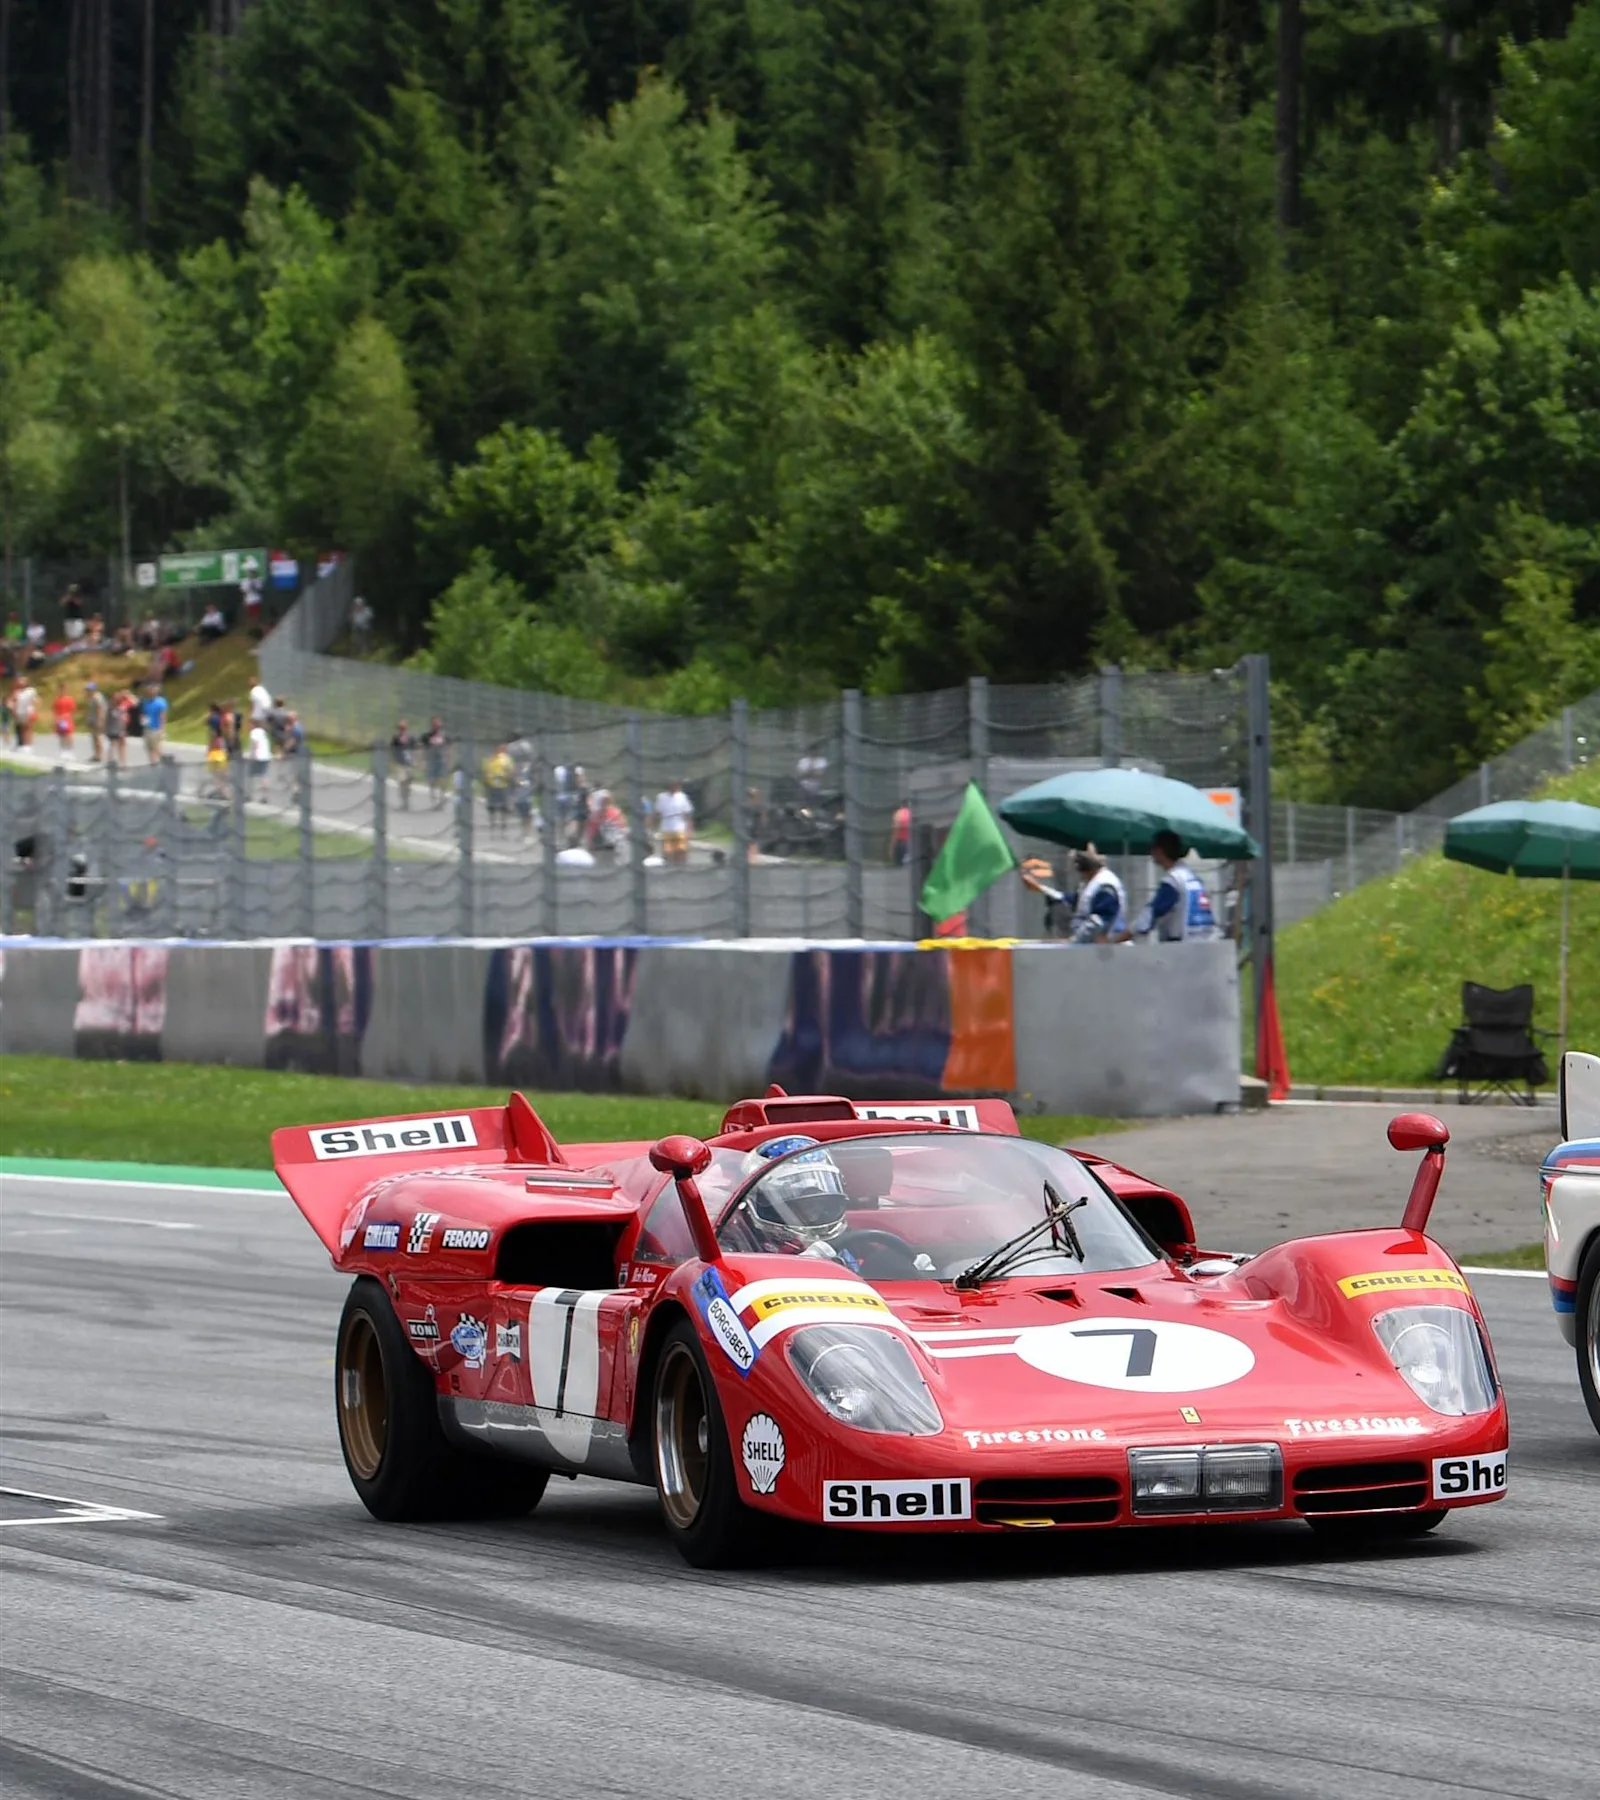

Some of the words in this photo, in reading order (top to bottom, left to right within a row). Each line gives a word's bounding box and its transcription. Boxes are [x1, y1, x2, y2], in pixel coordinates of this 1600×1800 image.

[857, 1110, 969, 1129] hll
[321, 1120, 467, 1154] Shell
[442, 1229, 488, 1249] FERODO
[1351, 1275, 1463, 1290] CARELLO
[763, 1295, 879, 1310] CARELLO
[409, 1323, 437, 1337] KONI
[554, 1290, 585, 1419] 7
[1069, 1328, 1157, 1378] 7
[1284, 1416, 1420, 1437] Firestone
[963, 1426, 1107, 1450] Firestone
[748, 1441, 780, 1461] SHELL
[1440, 1453, 1508, 1493] She
[829, 1482, 962, 1517] Shell
